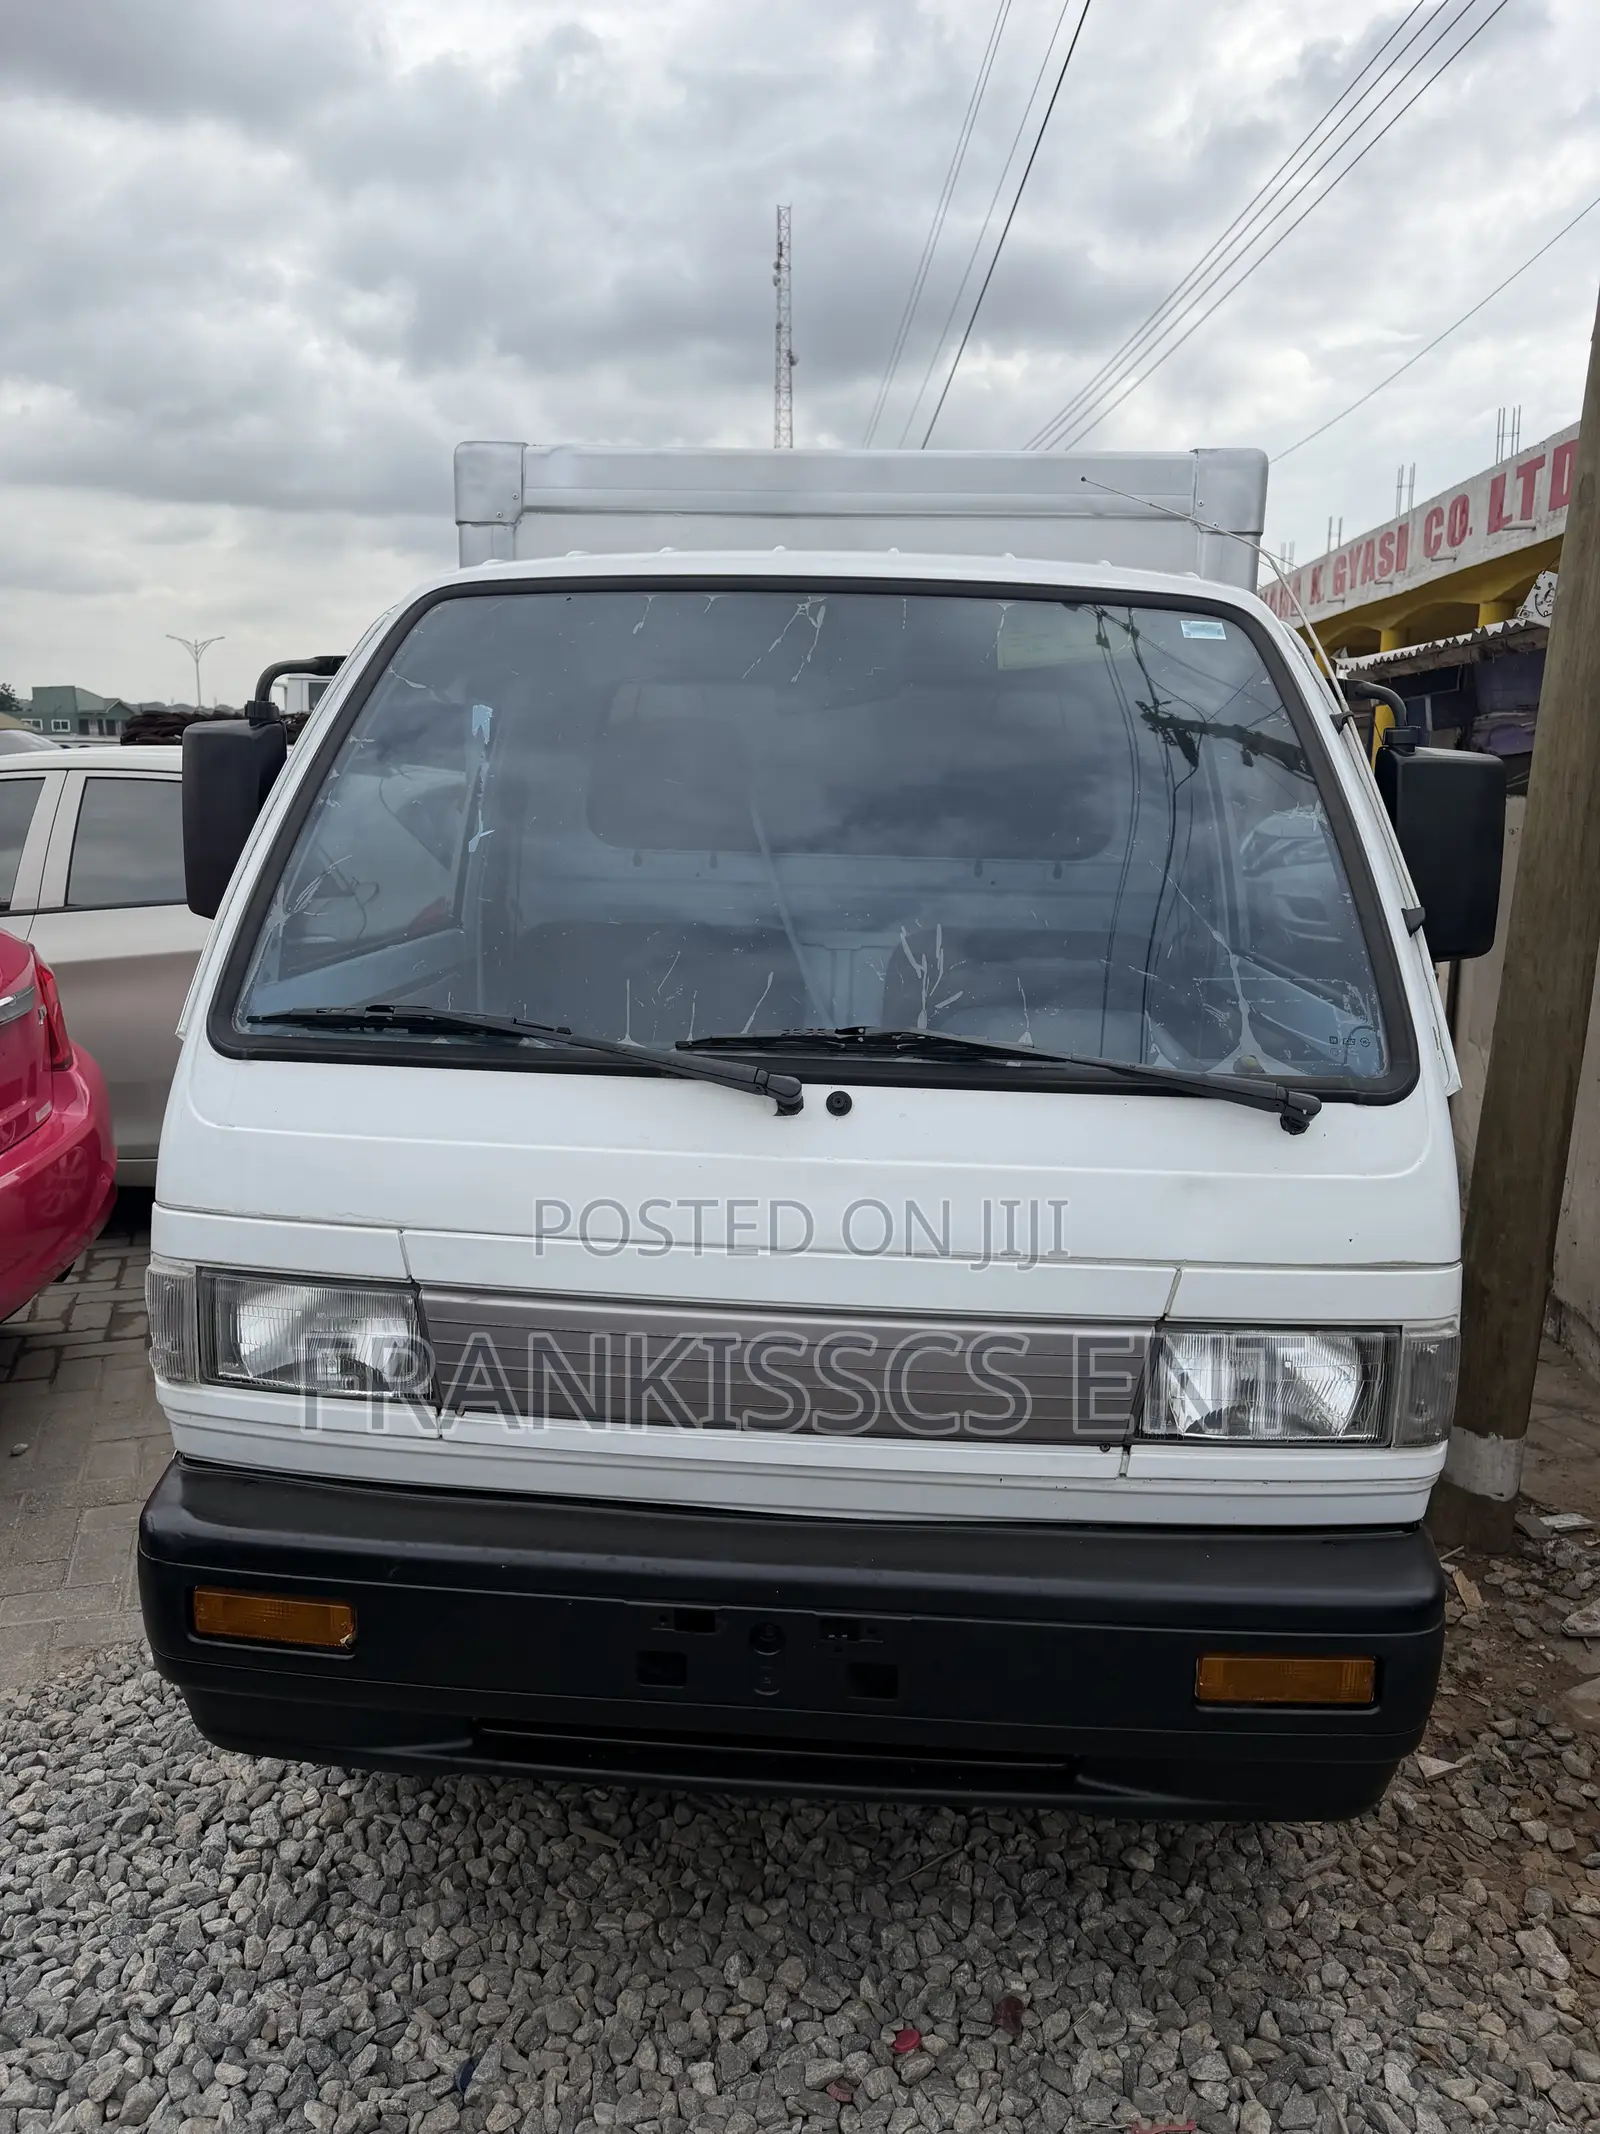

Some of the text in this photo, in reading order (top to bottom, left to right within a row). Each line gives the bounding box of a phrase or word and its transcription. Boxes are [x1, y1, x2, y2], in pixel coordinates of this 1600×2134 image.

[1332, 523, 1409, 597] GYASI
[1424, 493, 1473, 558] CO.
[1487, 438, 1579, 535] LTD
